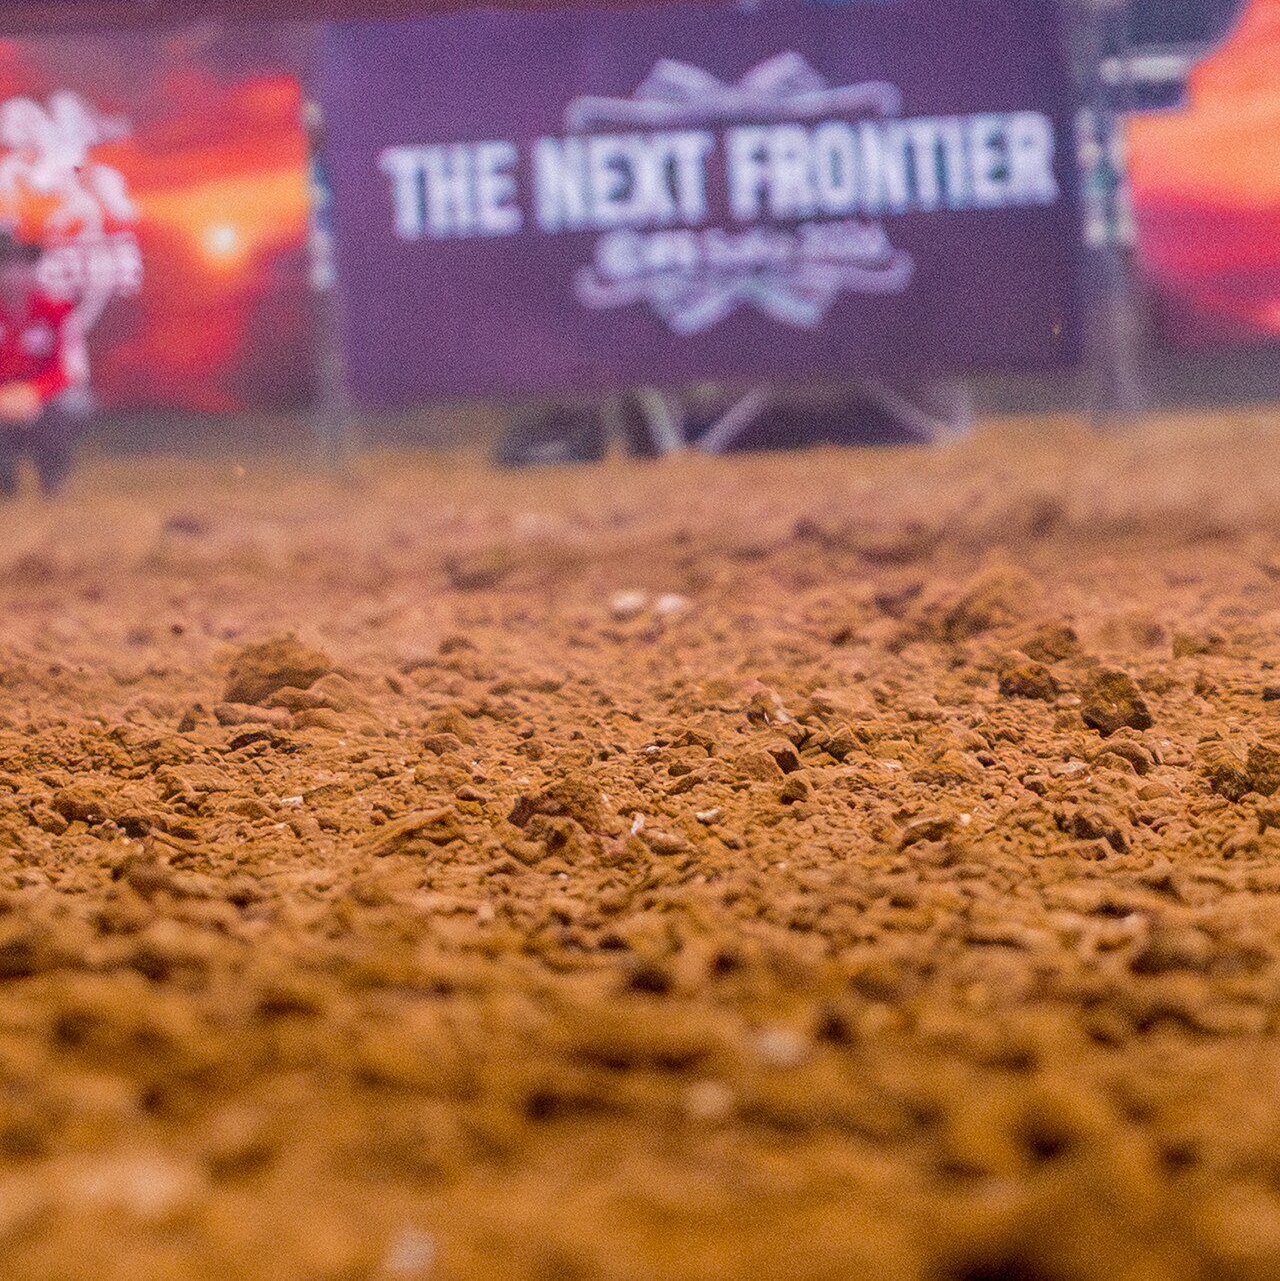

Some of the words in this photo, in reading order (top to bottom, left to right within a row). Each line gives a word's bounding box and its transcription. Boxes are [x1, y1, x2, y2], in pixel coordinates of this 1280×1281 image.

[378, 140, 523, 241] THE
[531, 127, 714, 233] NEXT
[728, 110, 1059, 221] FRONTIER
